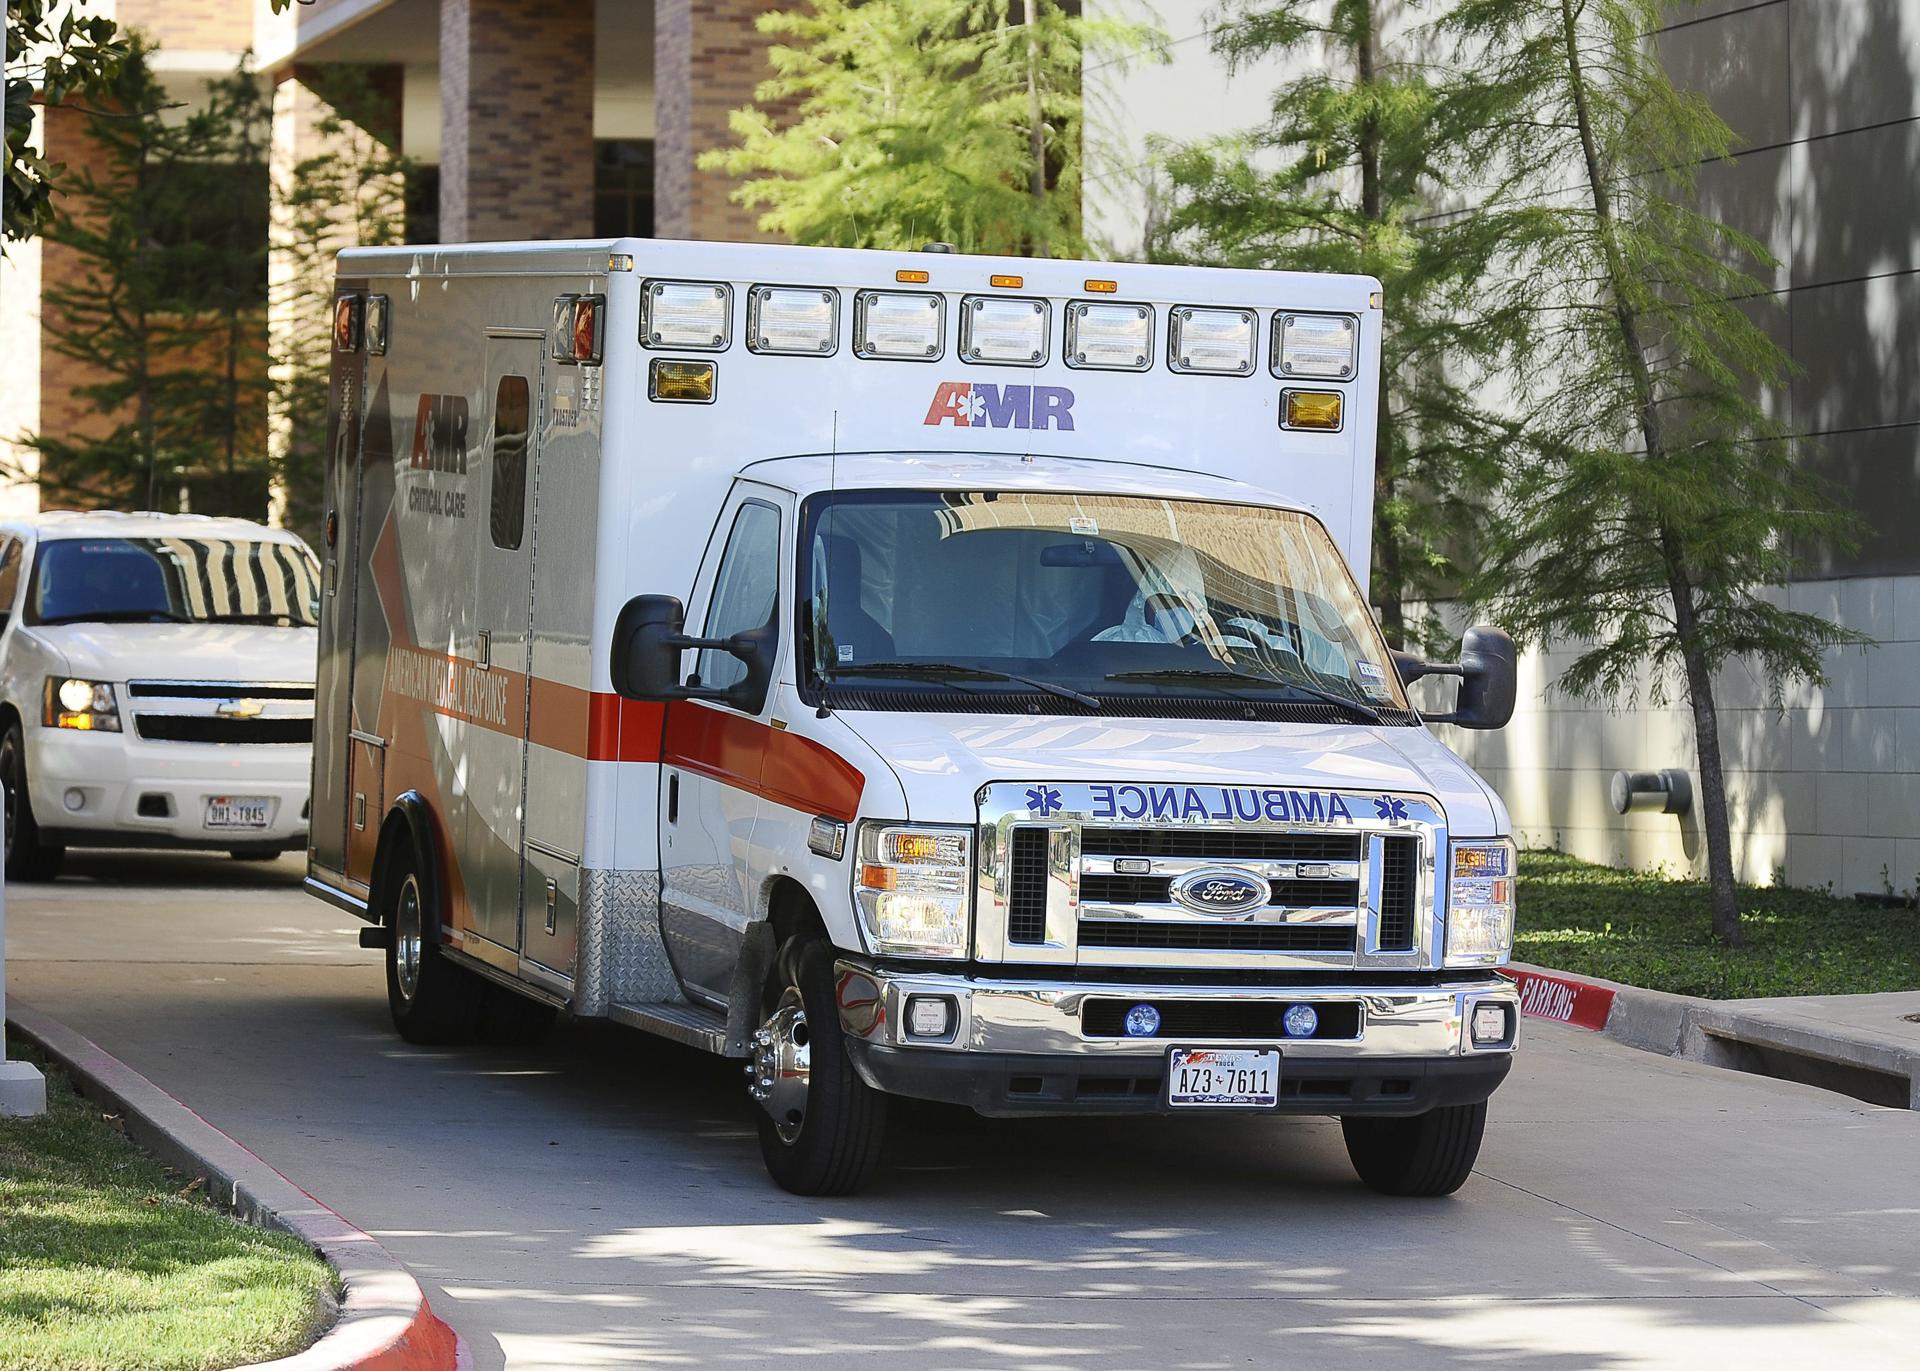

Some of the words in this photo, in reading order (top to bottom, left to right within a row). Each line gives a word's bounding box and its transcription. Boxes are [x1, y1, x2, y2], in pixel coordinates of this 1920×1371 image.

[923, 382, 1075, 431] AMR
[410, 393, 469, 475] AMR
[409, 486, 442, 515] CRITICAL
[445, 491, 466, 519] CARE
[388, 646, 429, 701] AMERICAN
[464, 666, 508, 726] RESPONSE
[1201, 881, 1248, 902] Ford
[1521, 977, 1577, 1021] PARKING
[1206, 1053, 1242, 1061] TEXAS
[1179, 1069, 1212, 1094] AZ3
[1226, 1069, 1270, 1095] 7611
